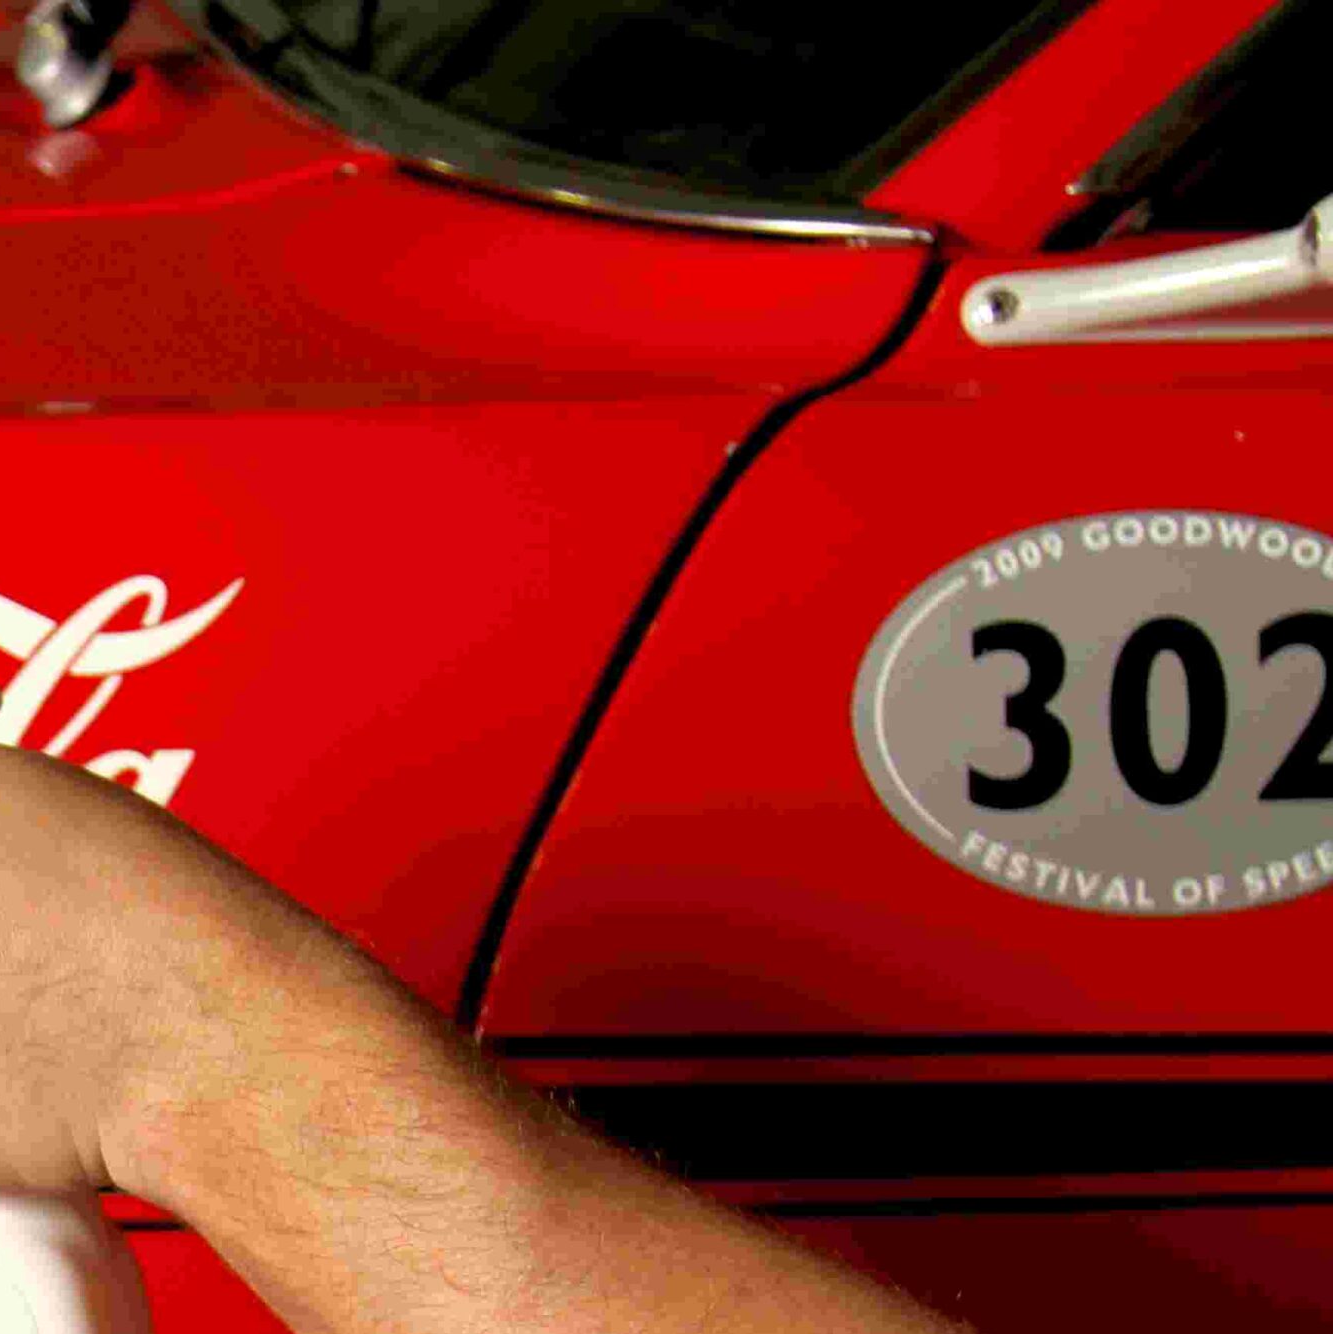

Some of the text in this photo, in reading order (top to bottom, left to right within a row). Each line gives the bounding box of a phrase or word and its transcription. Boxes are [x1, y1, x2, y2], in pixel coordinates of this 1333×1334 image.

[971, 533, 1065, 587] 2009
[966, 610, 1333, 812] 302
[959, 829, 1155, 910] FESTIVAL
[1172, 874, 1226, 908] OF
